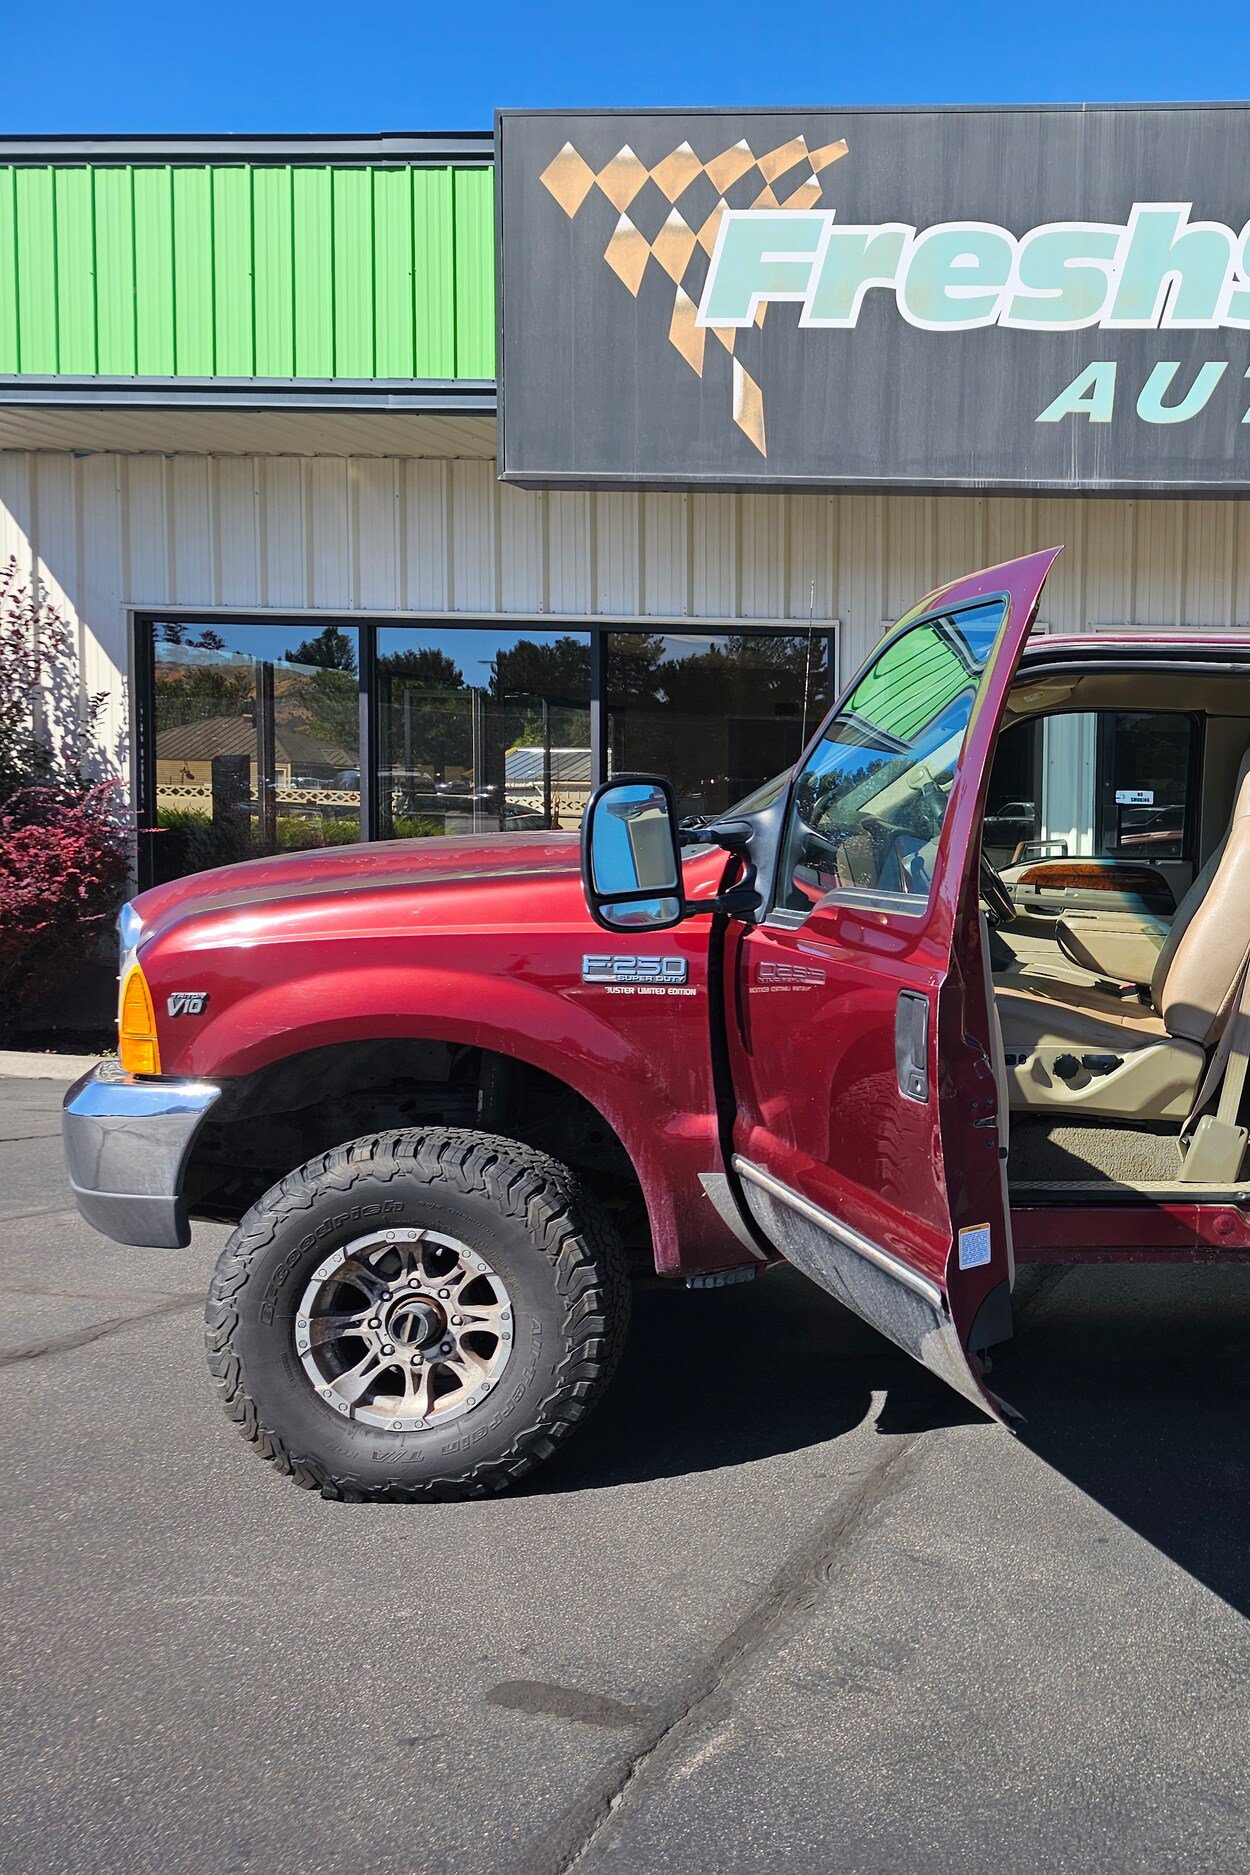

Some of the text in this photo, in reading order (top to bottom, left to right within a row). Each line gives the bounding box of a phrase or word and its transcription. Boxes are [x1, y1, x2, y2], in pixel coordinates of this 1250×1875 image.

[655, 975, 687, 983] DUTY
[637, 987, 666, 995] LIMITED
[668, 988, 697, 996] EDITION
[167, 997, 203, 1017] V10
